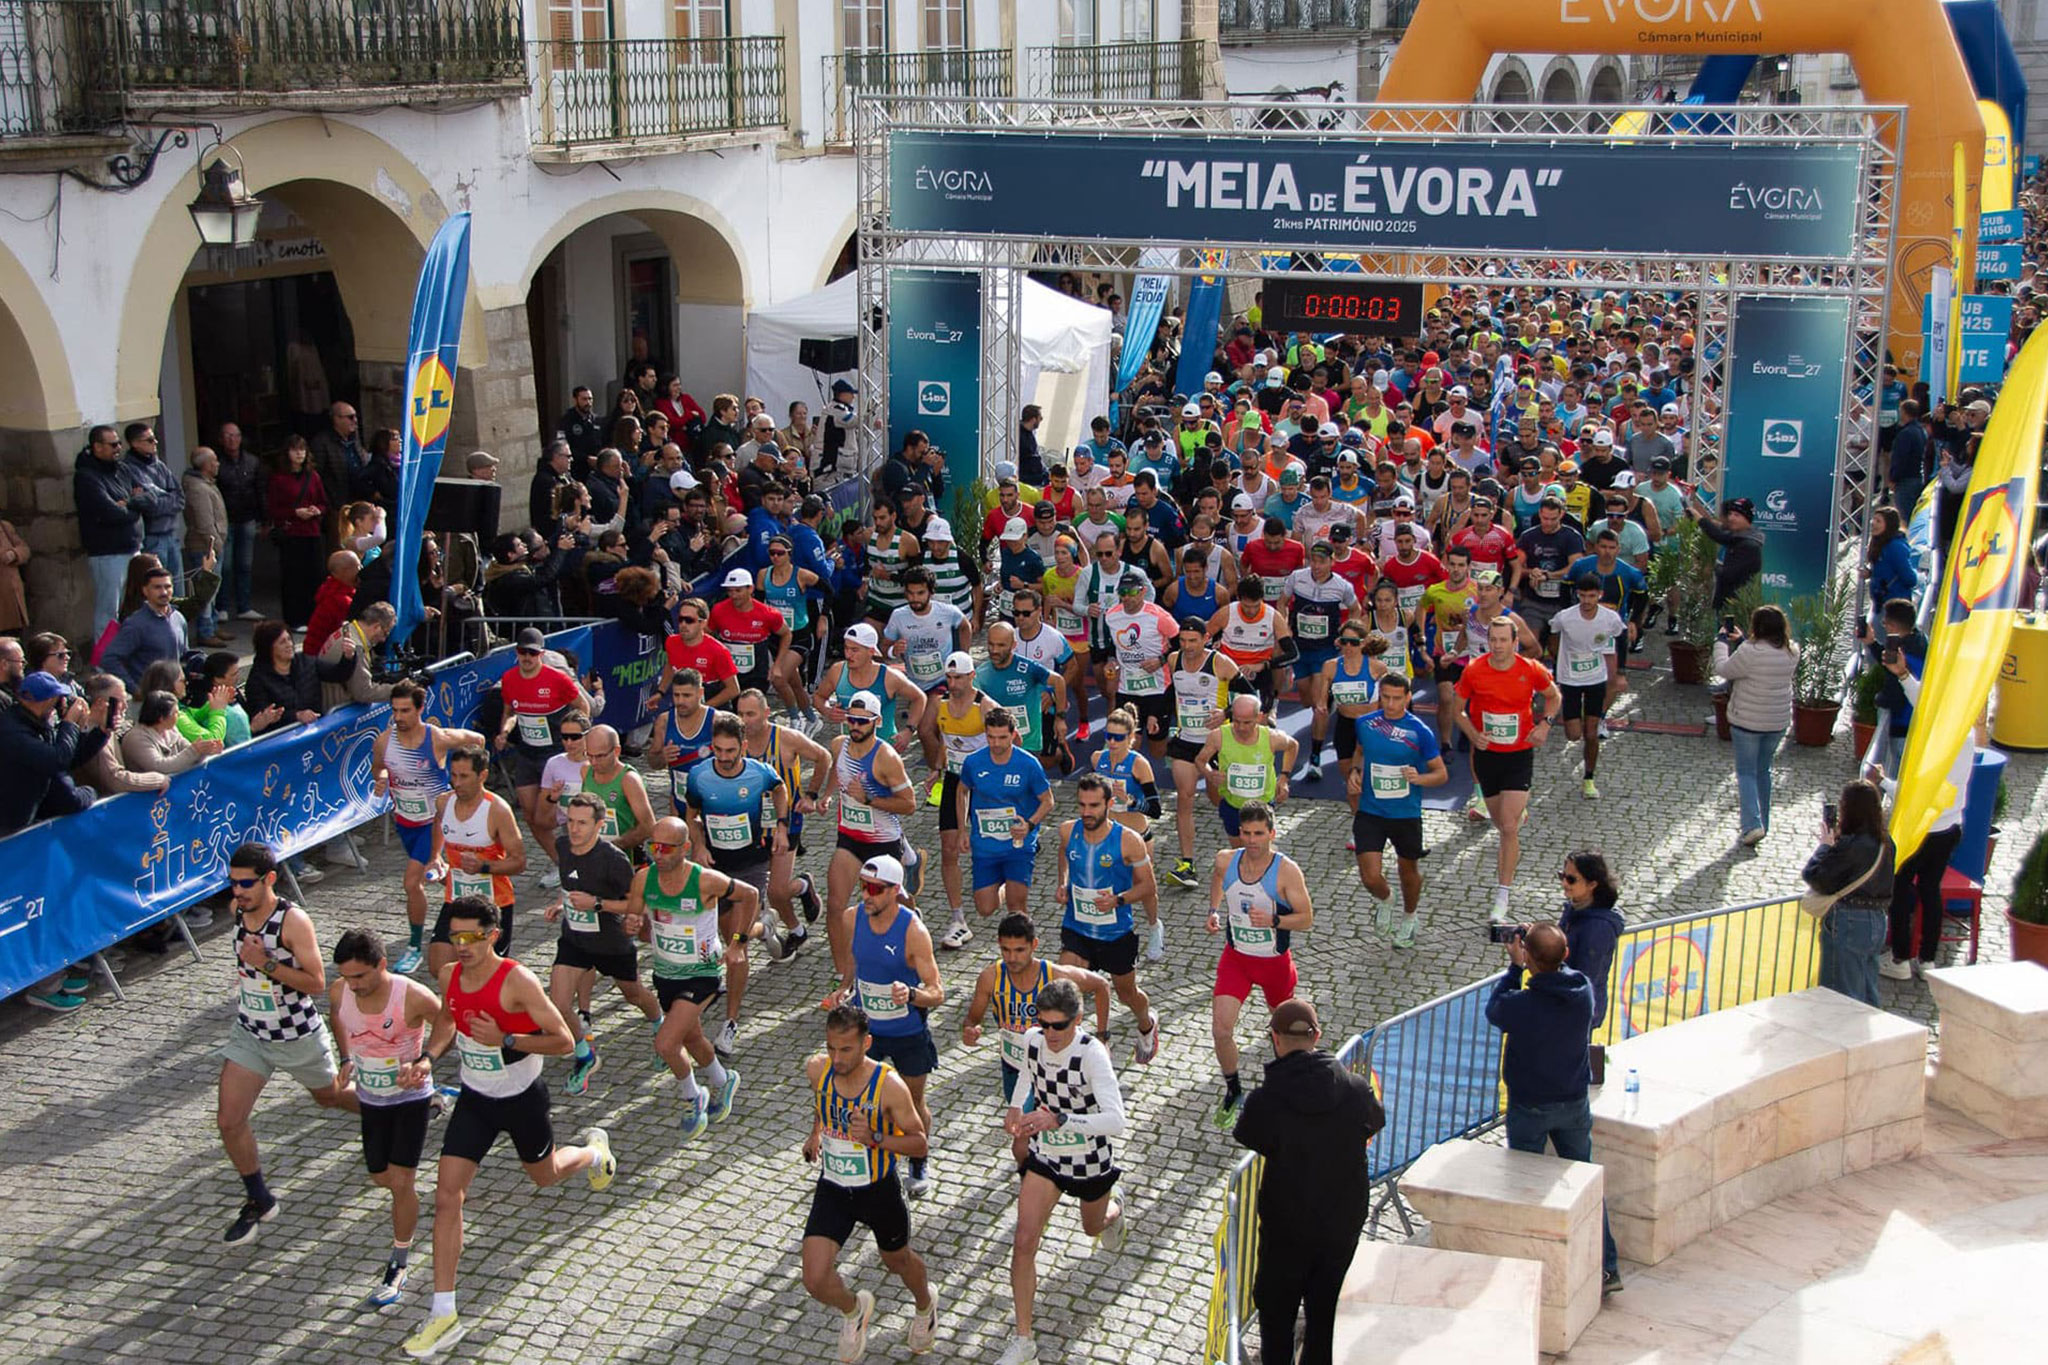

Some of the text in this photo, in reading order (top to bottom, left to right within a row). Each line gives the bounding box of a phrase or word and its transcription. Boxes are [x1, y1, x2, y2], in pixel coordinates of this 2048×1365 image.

[1638, 32, 1762, 44] Câmara Municipal
[916, 164, 993, 192] ÉVORA
[1309, 193, 1337, 212] DE
[1729, 182, 1822, 210] ÉVORA
[1304, 216, 1384, 232] PATRIMÓNIO
[1385, 220, 1417, 233] 2025
[1982, 216, 2003, 226] SUB
[1305, 294, 1401, 321] 0:00:03
[1961, 302, 1983, 315] UB
[1960, 316, 1992, 331] H25
[907, 328, 964, 342] Évora 27
[1753, 360, 1787, 375] Évora
[1805, 364, 1821, 376] 27
[1757, 511, 1796, 521] Vila Galé
[1761, 573, 1787, 585] MS
[1379, 778, 1401, 790] 183
[987, 821, 1009, 832] 841
[716, 829, 743, 842] 936
[26, 896, 45, 920] 27
[1239, 930, 1266, 942] 453
[661, 935, 688, 954] 722
